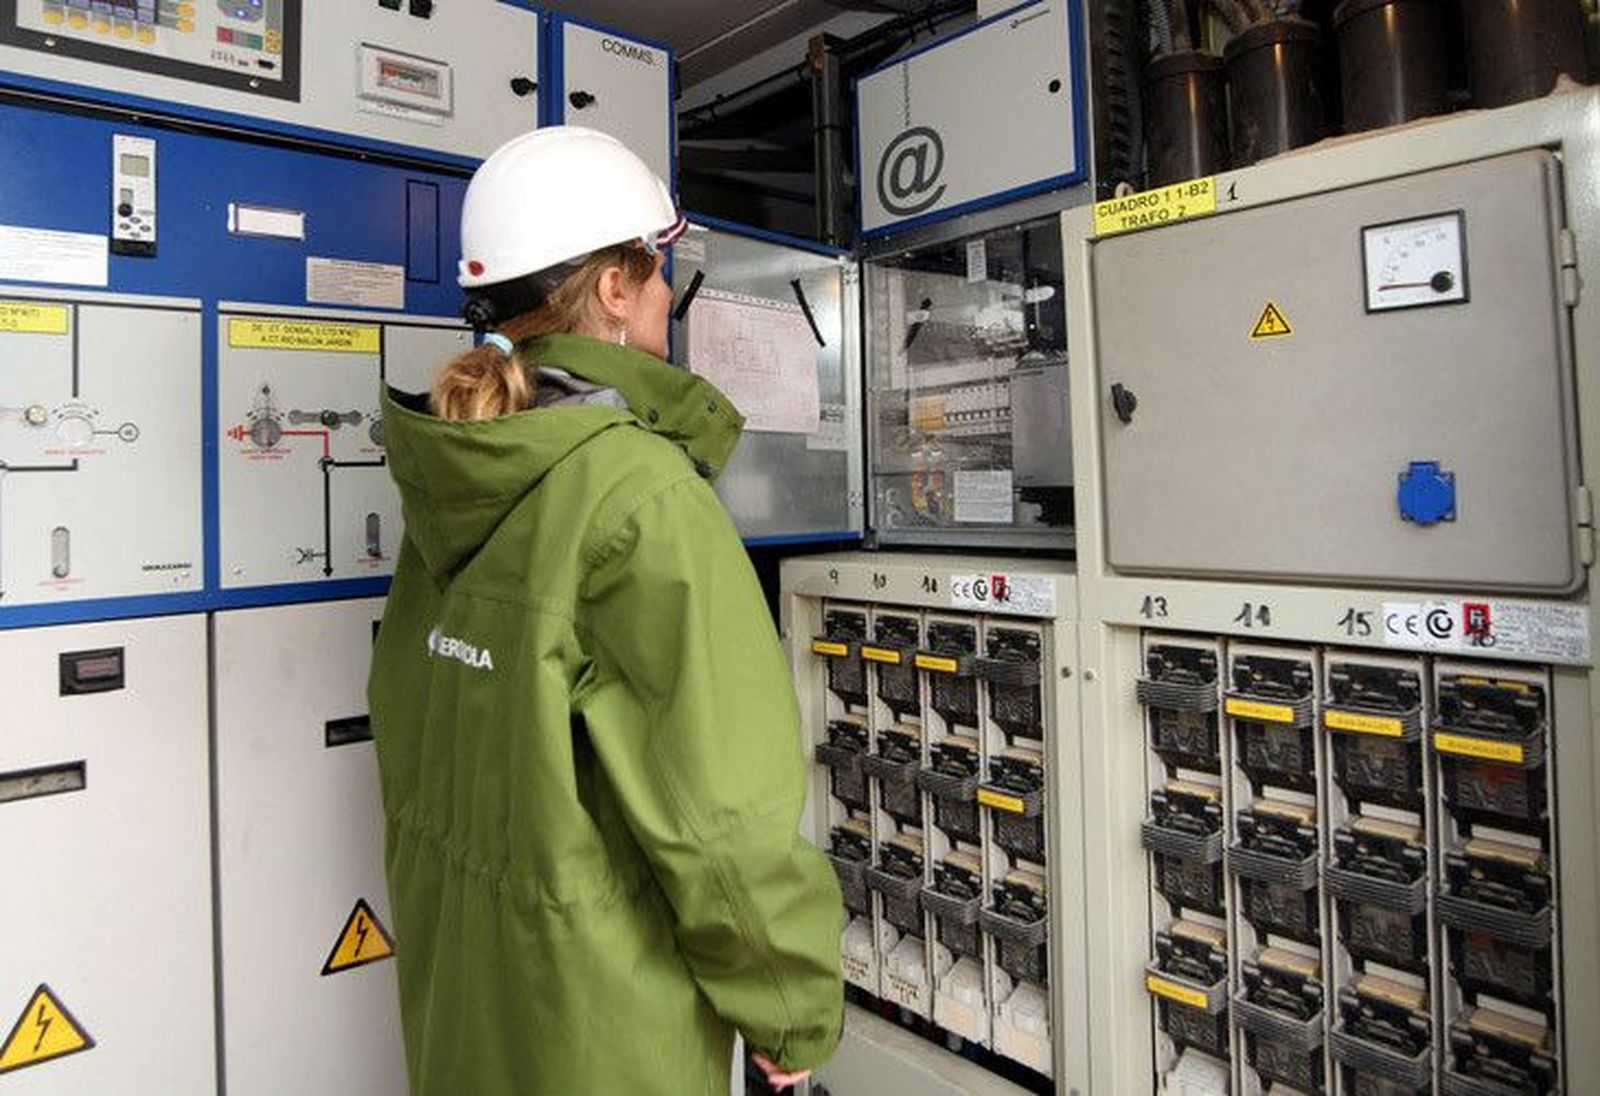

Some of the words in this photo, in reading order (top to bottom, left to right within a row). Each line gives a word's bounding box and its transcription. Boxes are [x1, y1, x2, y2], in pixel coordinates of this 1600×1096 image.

[1226, 181, 1238, 201] 1
[1097, 193, 1160, 218] CUADRO
[1120, 208, 1170, 229] TRAFO
[829, 569, 839, 585] 9
[873, 572, 887, 590] 10
[1140, 596, 1168, 618] 13
[1337, 607, 1374, 636] 15
[1386, 613, 1418, 636] CE
